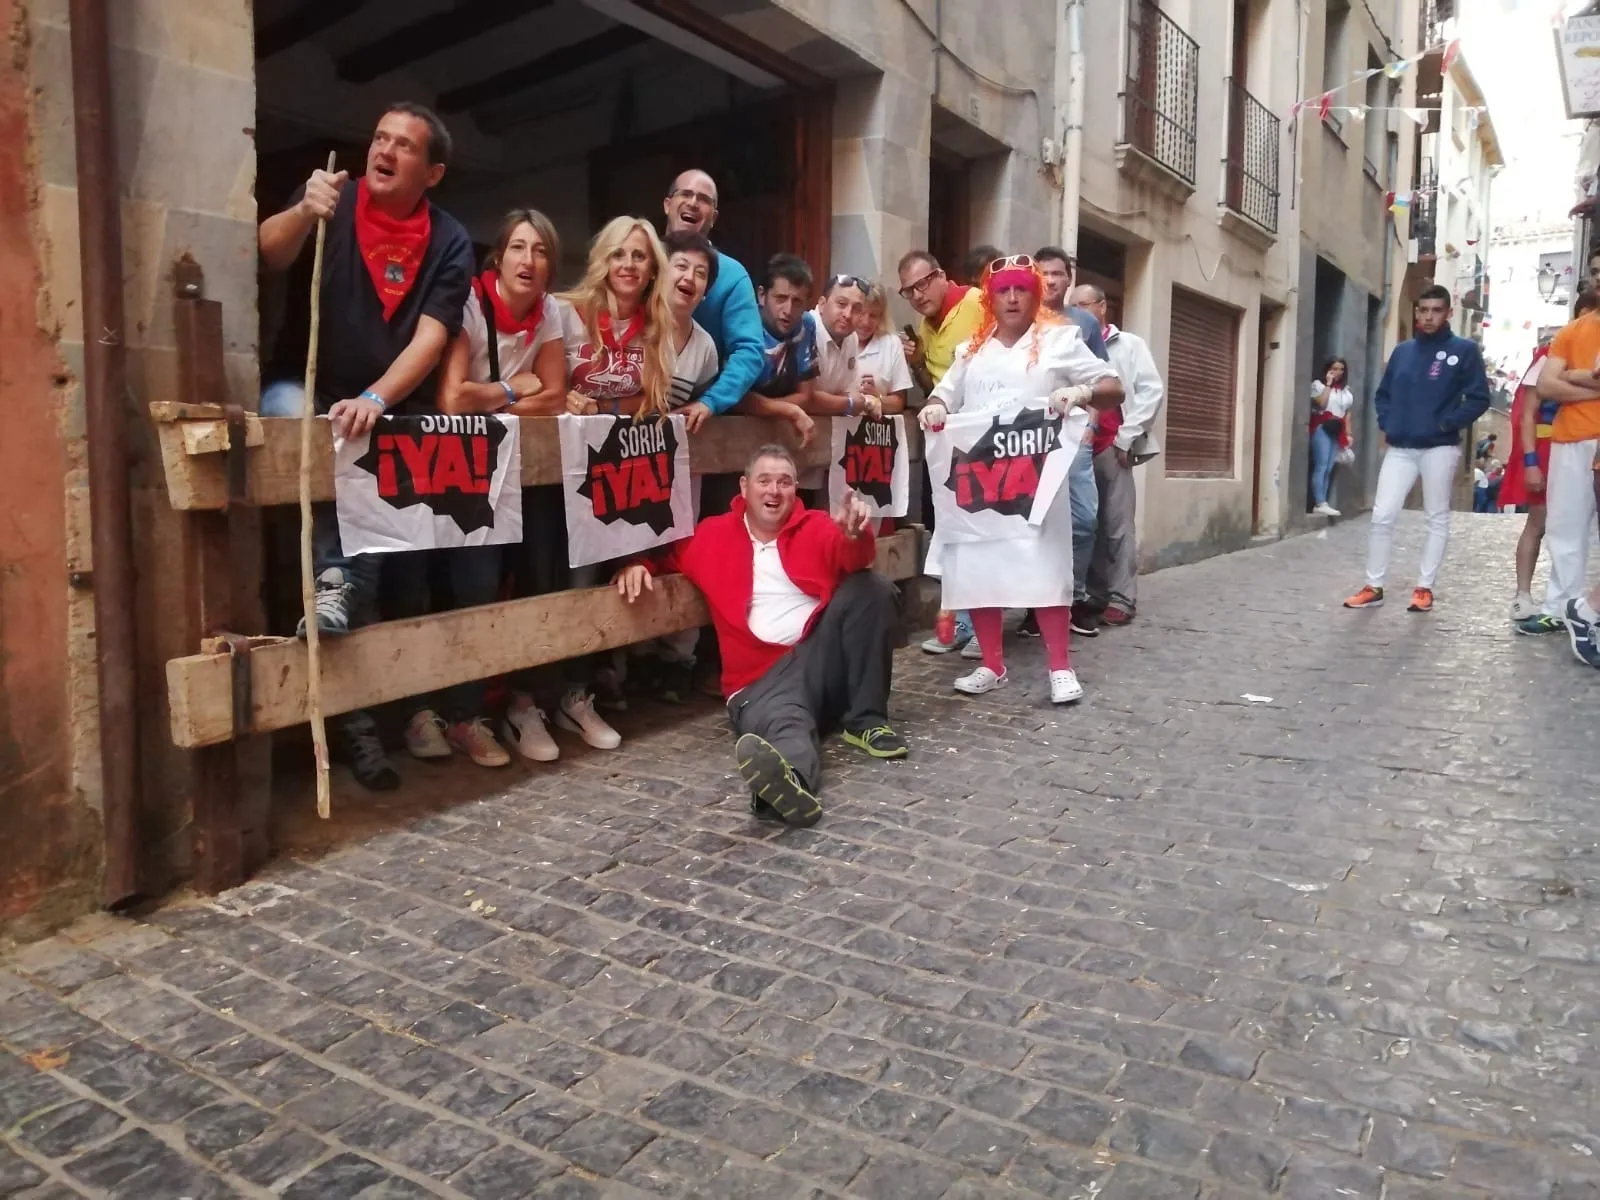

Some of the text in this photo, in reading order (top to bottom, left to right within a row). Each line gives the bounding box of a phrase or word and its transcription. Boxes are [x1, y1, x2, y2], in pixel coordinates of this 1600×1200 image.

[618, 423, 667, 458] SORIA
[864, 422, 892, 447] SORIA
[993, 426, 1055, 459] SORIA
[377, 434, 490, 497] ¡YA!
[591, 452, 671, 516] ¡YA!
[846, 444, 893, 484] ¡YA!
[955, 453, 1048, 506] ¡YA
